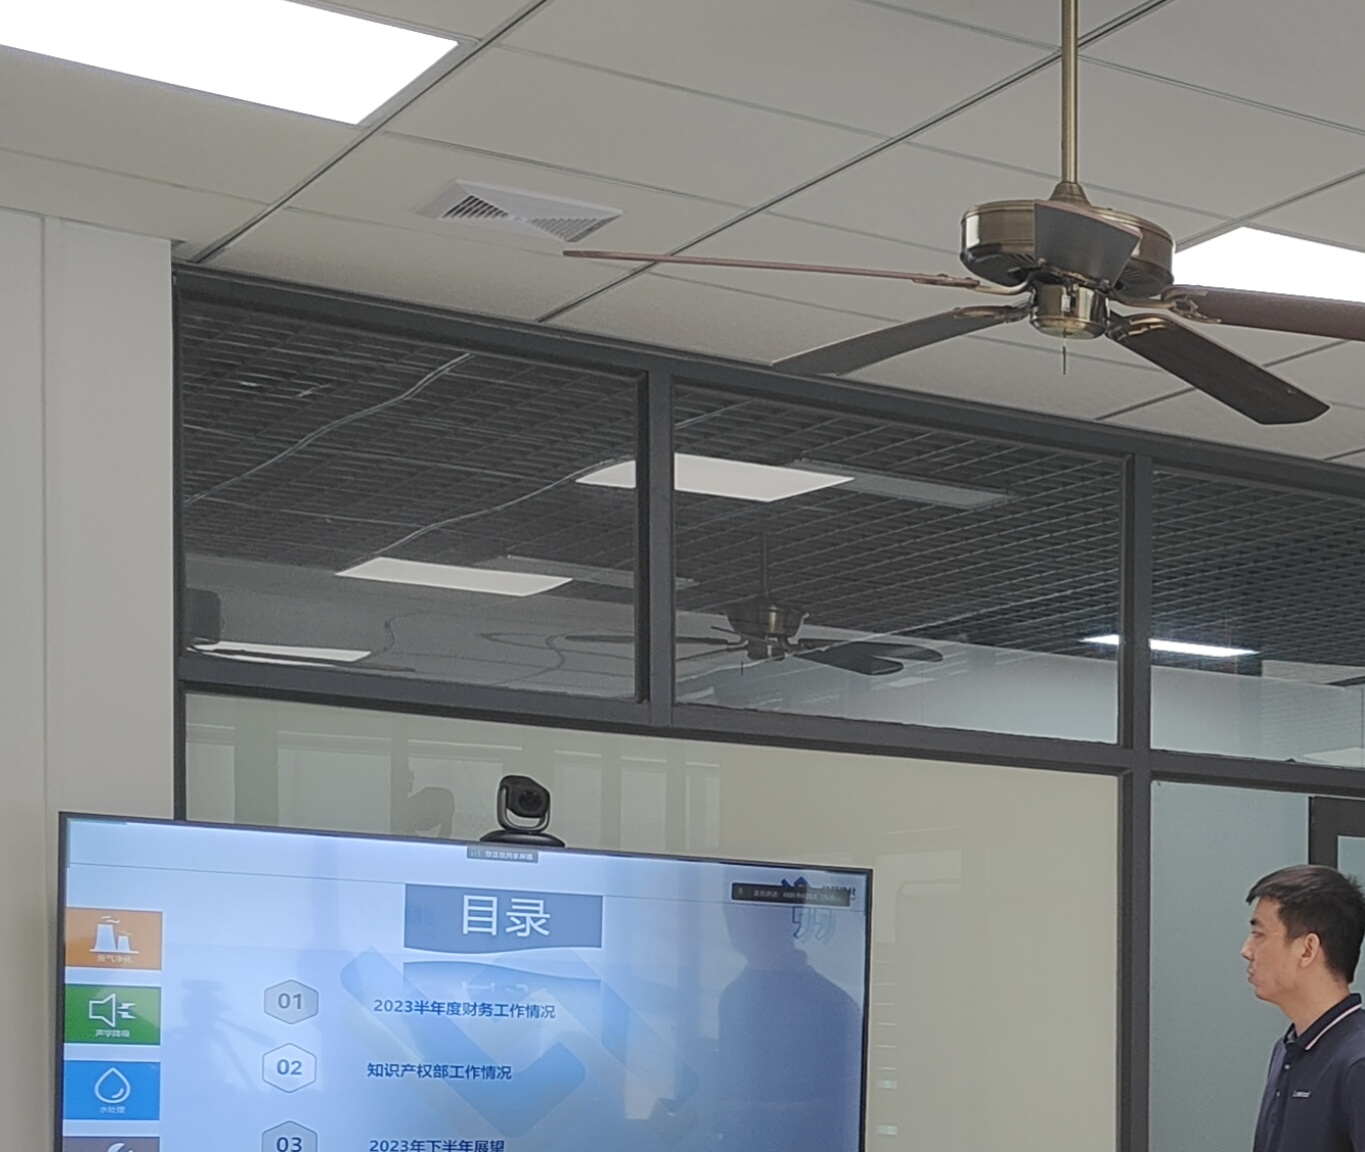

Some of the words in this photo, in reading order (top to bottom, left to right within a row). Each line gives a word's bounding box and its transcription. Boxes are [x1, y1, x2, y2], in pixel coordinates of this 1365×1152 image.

[462, 894, 551, 938] 目录
[277, 992, 303, 1010] 01
[373, 999, 556, 1019] 2023半年度财务工作情况
[276, 1058, 303, 1076] 02
[366, 1062, 512, 1080] 知识产权部工作情况
[275, 1137, 303, 1152] 03
